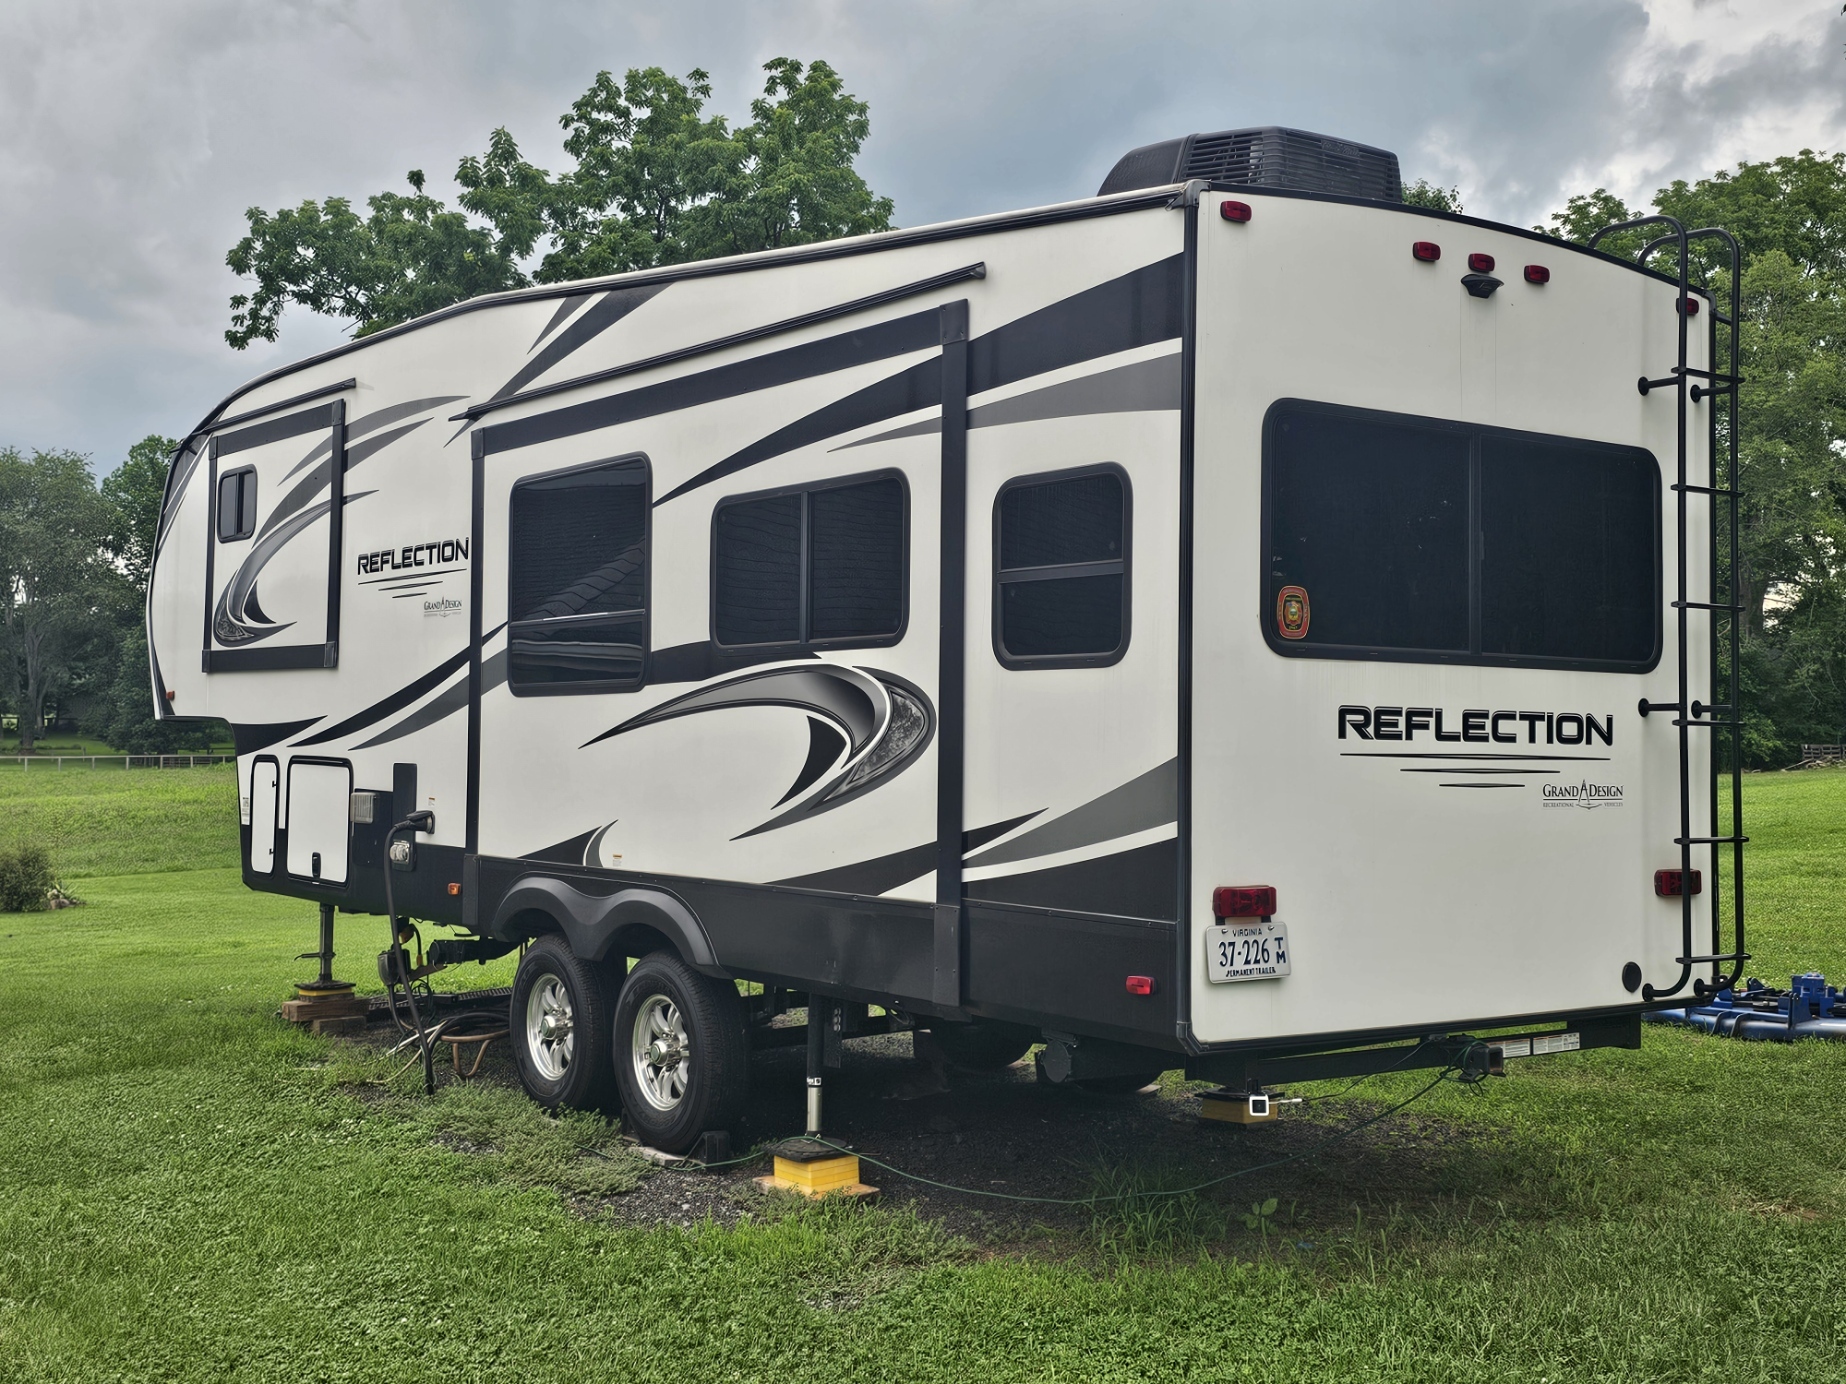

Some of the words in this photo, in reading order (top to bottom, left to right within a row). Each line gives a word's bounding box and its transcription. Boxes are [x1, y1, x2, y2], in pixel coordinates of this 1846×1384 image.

[357, 537, 469, 575] REFLECTION
[1338, 705, 1613, 746] REFLECTION
[1543, 784, 1579, 797] GRAND
[1589, 784, 1623, 797] DESIGN
[1232, 928, 1262, 937] VIRGINIA
[1226, 968, 1255, 977] PERMANENT
[1255, 966, 1276, 976] TRAILER
